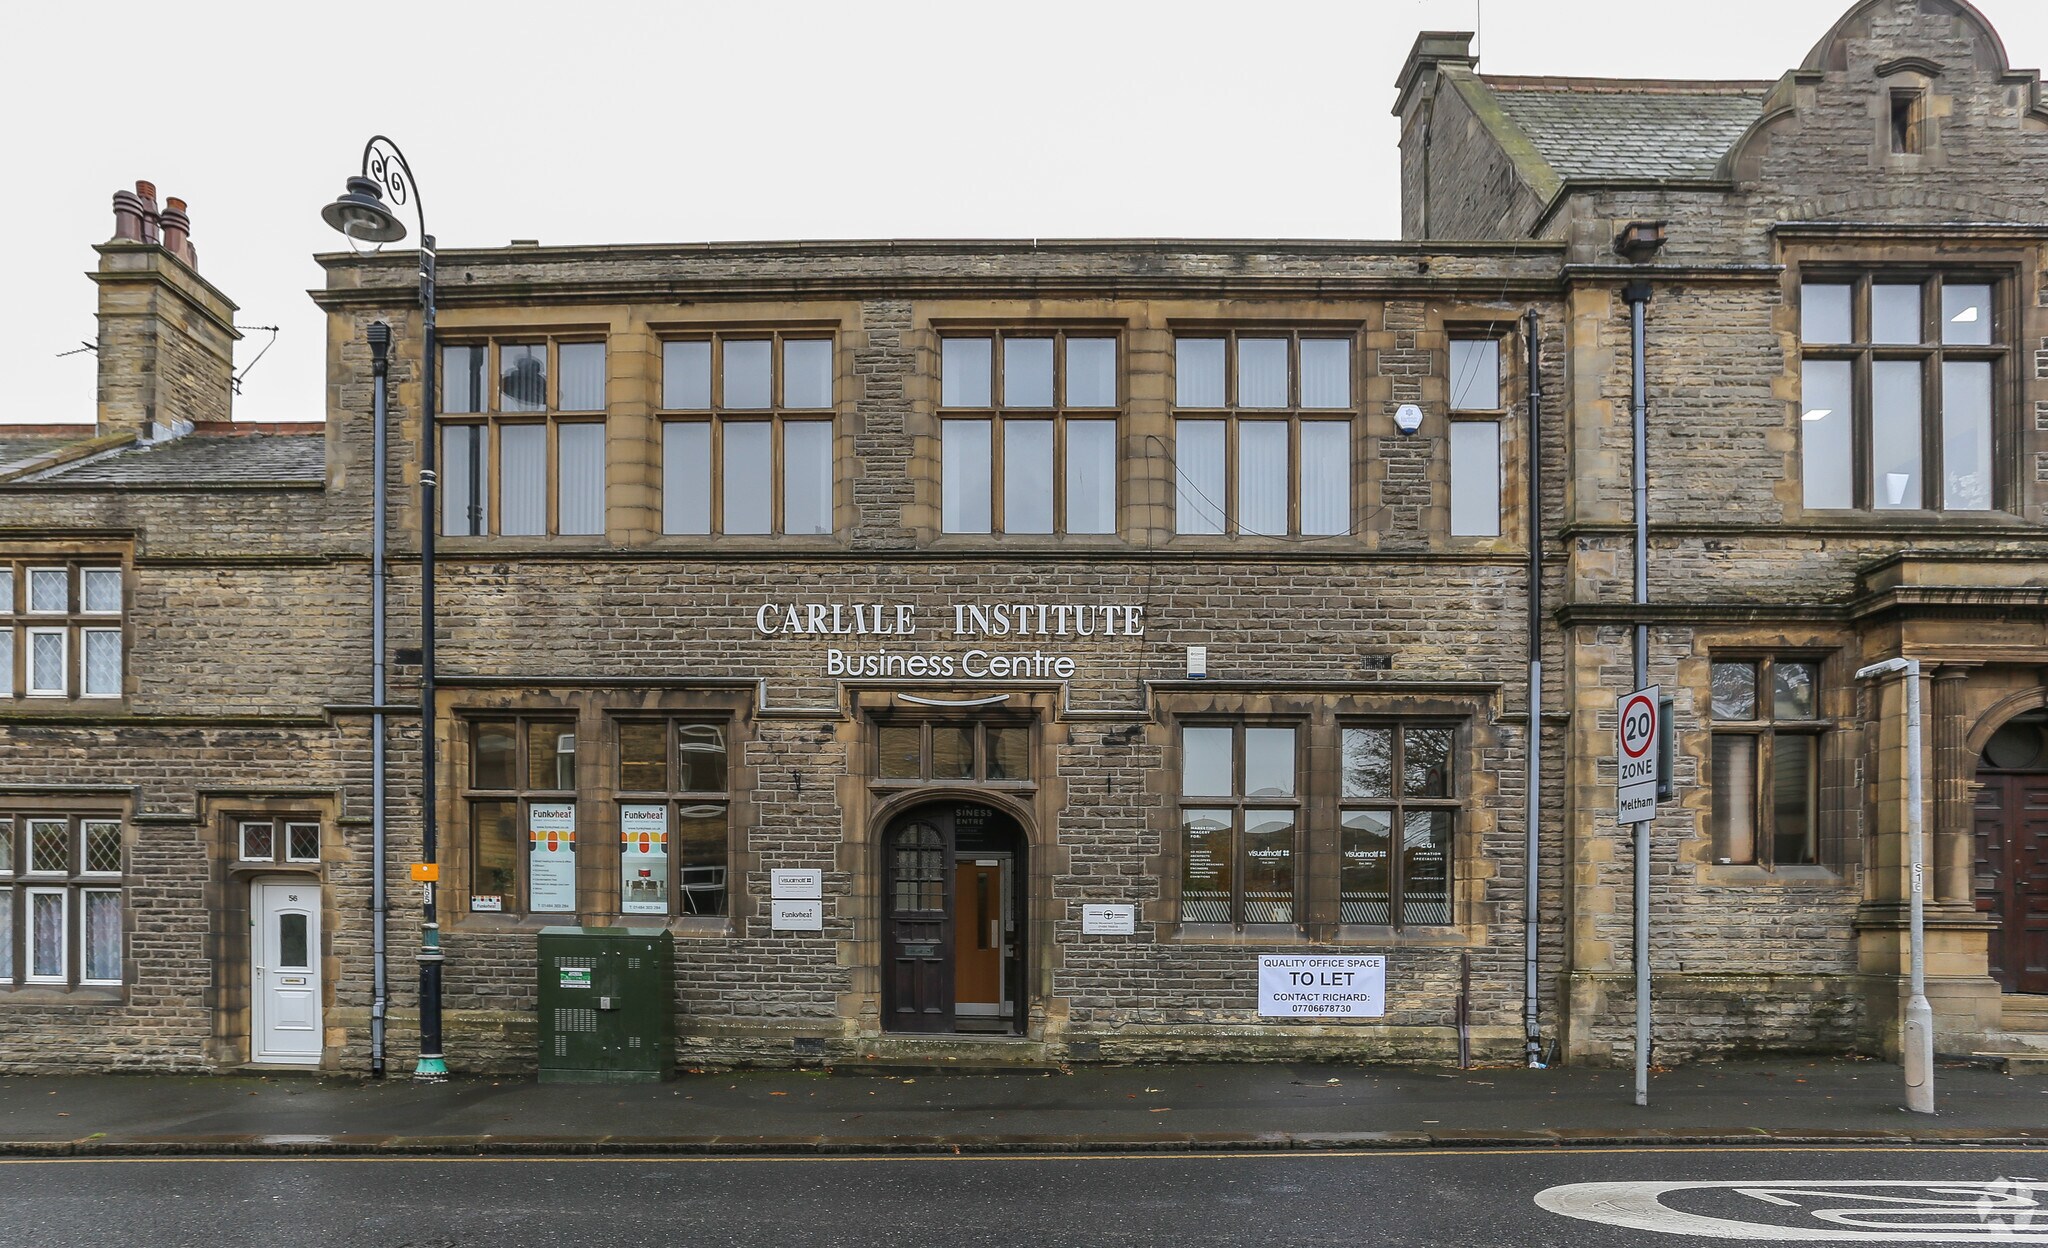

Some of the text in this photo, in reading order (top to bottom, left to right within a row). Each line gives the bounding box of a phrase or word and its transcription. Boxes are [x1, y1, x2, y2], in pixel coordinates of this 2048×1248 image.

[756, 603, 1145, 636] CARLILE INSTITUTE
[827, 648, 1076, 678] Business Centre
[1626, 712, 1650, 741] 20
[1621, 759, 1652, 779] ZONE
[1620, 797, 1653, 812] Meltham
[533, 810, 572, 819] Funkyheat
[624, 811, 663, 820] Funkyheat
[956, 809, 992, 817] SINESS
[1263, 959, 1380, 968] QUALITY OFFICE SPACE
[1289, 972, 1355, 986] TO LET
[1273, 993, 1370, 1001] CONTACT RICHARD:
[1292, 1004, 1351, 1013] 07706678730
